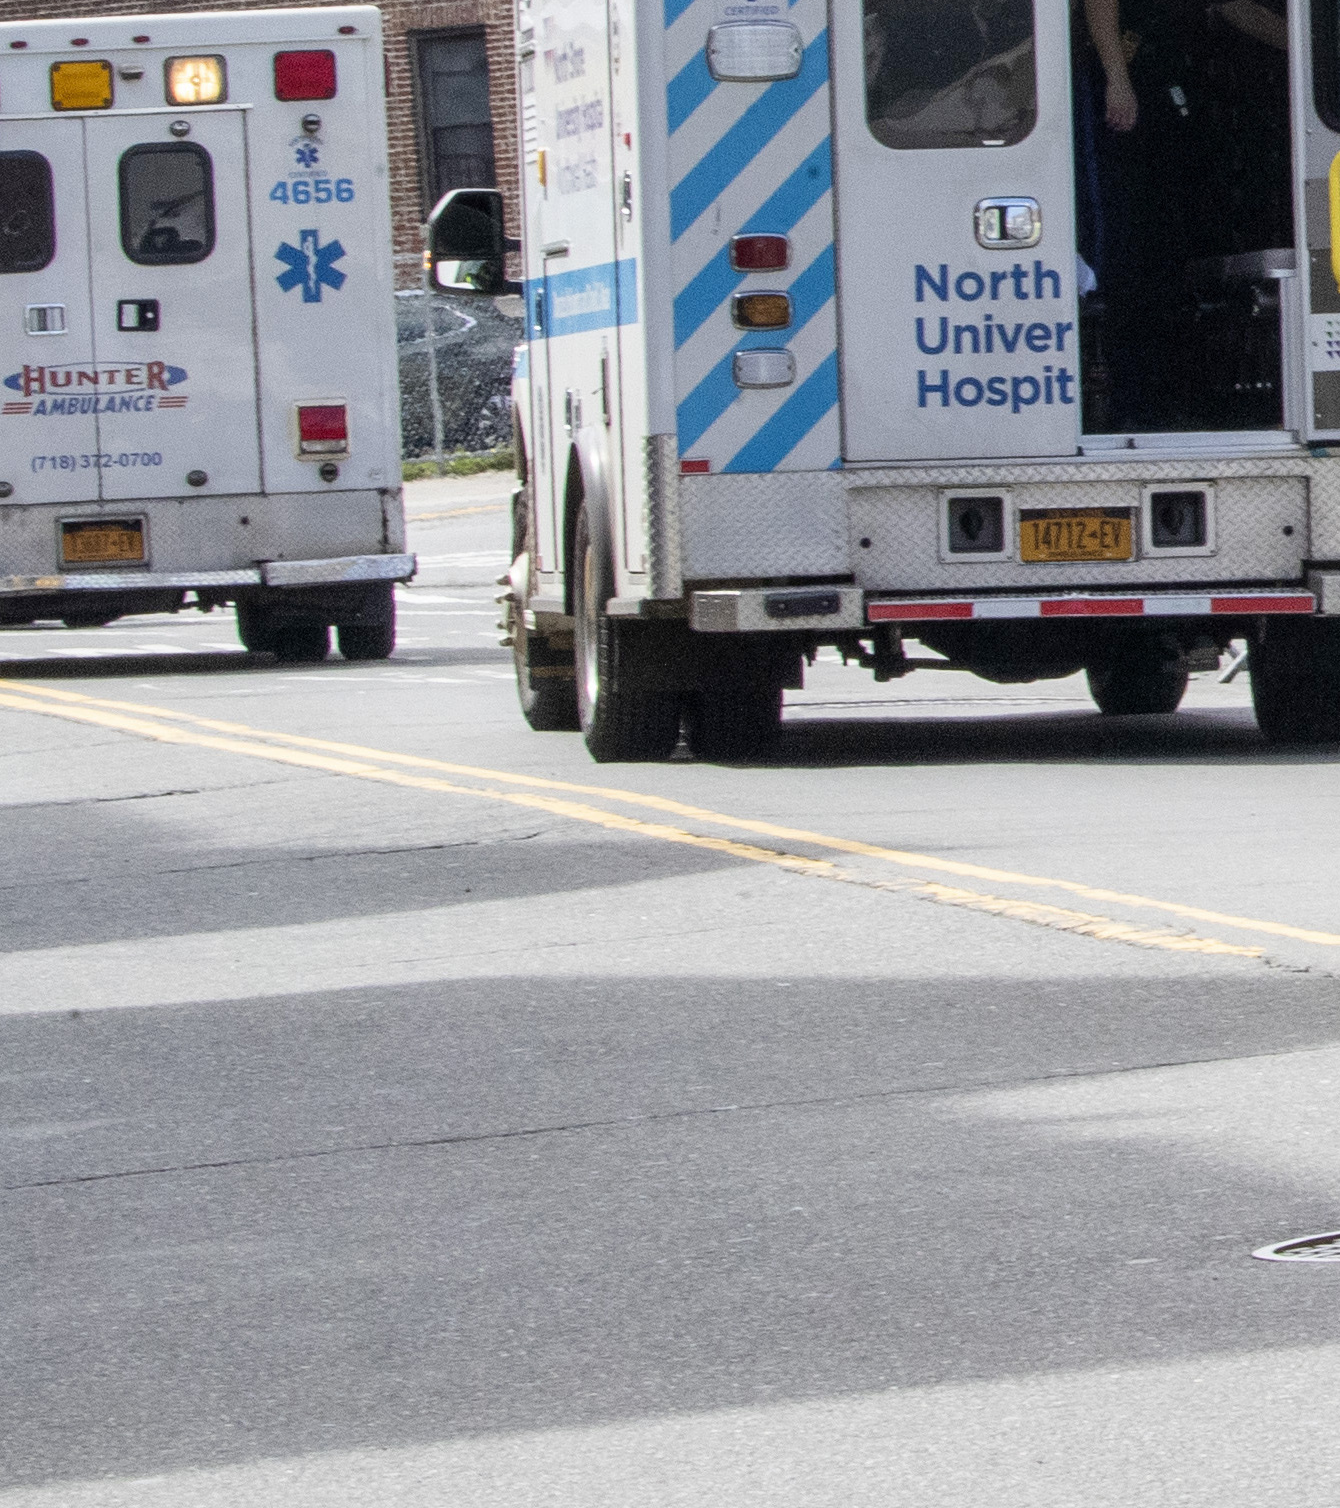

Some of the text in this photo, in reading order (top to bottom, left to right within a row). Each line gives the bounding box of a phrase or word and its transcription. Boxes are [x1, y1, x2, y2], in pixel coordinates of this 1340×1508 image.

[269, 177, 355, 205] 4656
[914, 260, 1061, 302] North
[915, 314, 1073, 355] Univer
[22, 360, 169, 397] HUNTER
[917, 365, 1075, 414] Hospit
[33, 394, 156, 416] AMBULANCE
[31, 451, 163, 473] (718) 372-0700
